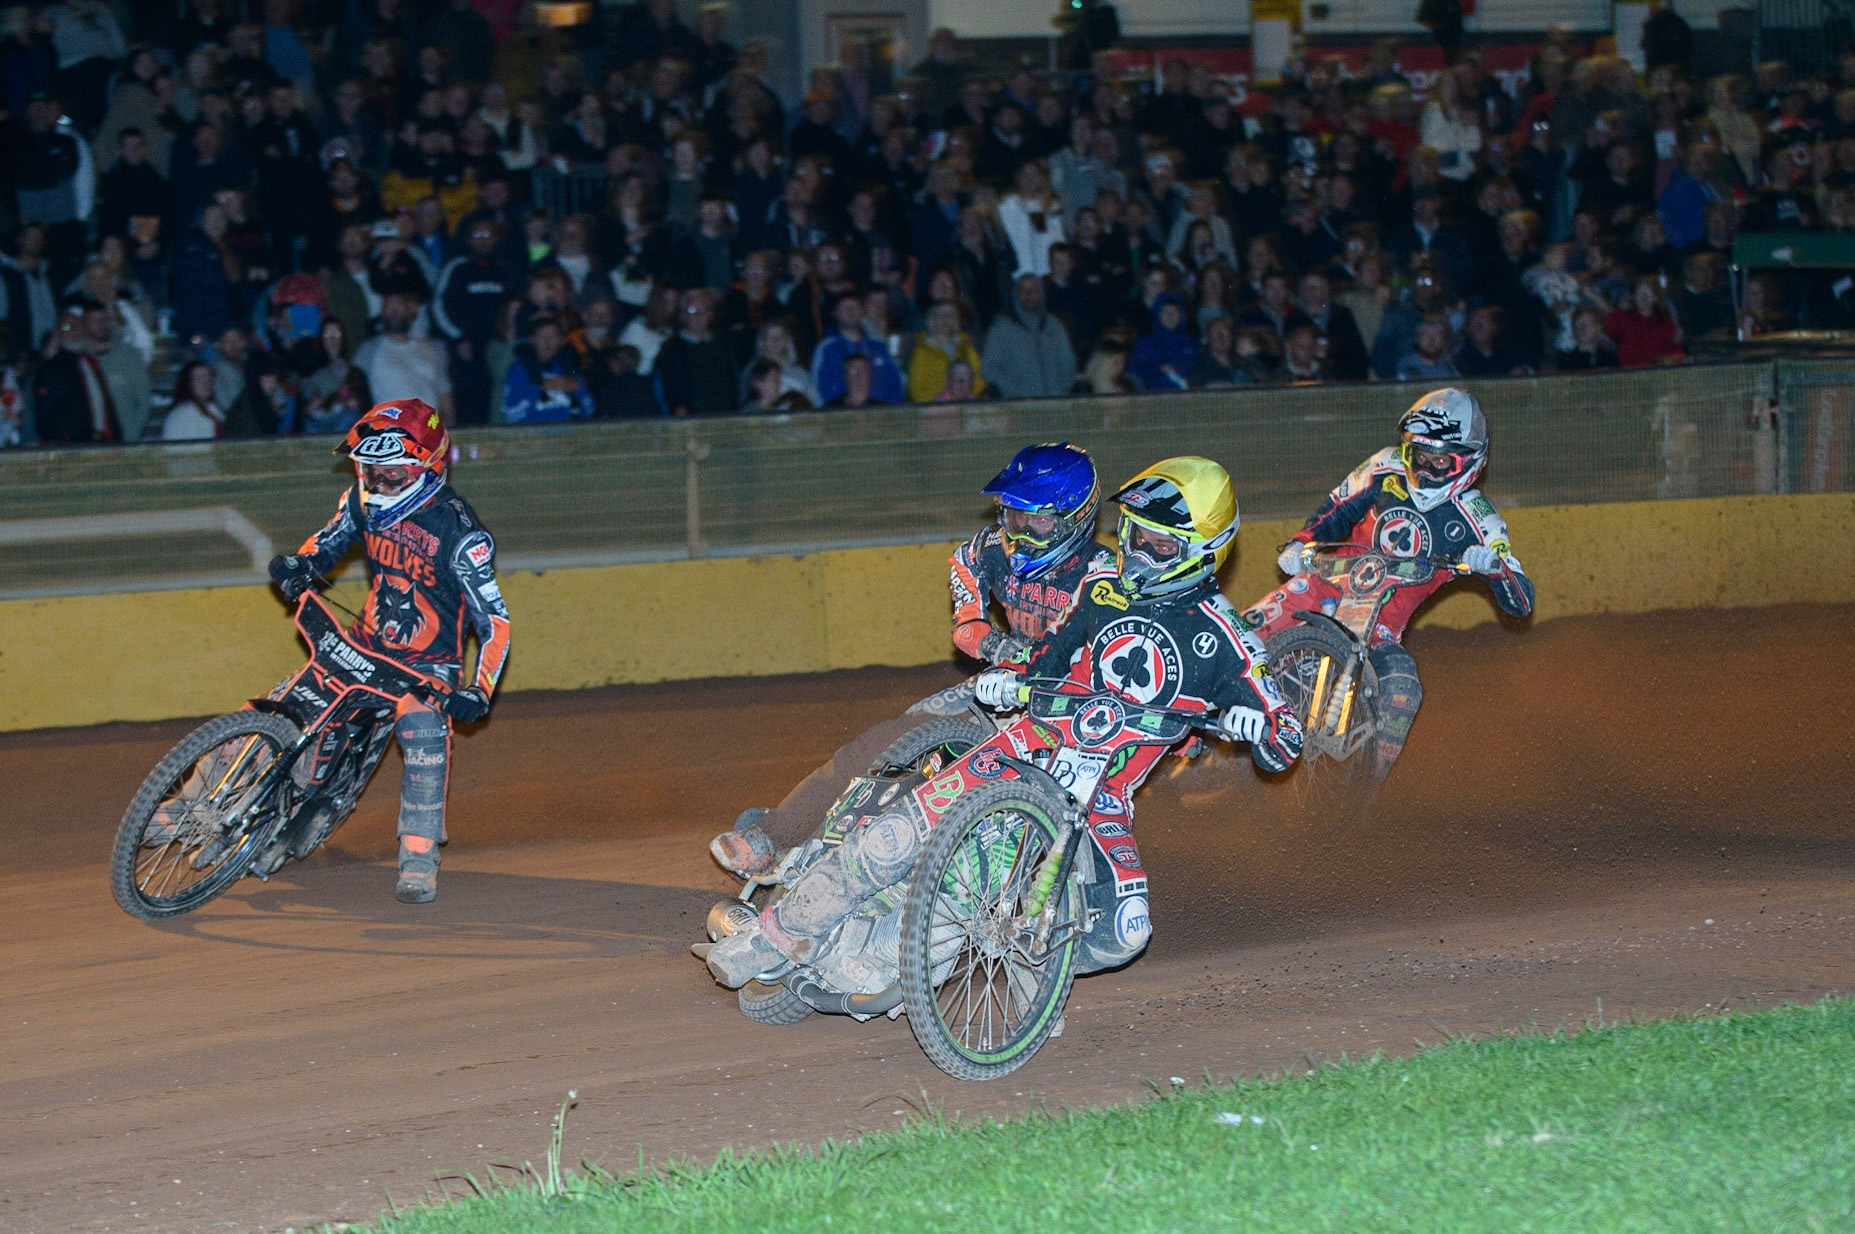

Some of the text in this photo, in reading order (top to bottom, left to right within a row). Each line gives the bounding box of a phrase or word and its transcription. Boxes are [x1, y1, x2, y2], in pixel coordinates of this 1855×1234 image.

[363, 530, 437, 587] WOLVES
[1021, 581, 1073, 610] PARR
[1100, 622, 1178, 681] BELLE VUE ACES
[1198, 634, 1214, 654] 4
[333, 641, 376, 678] PARRYS
[294, 685, 328, 708] JWP
[1116, 851, 1137, 861] STS
